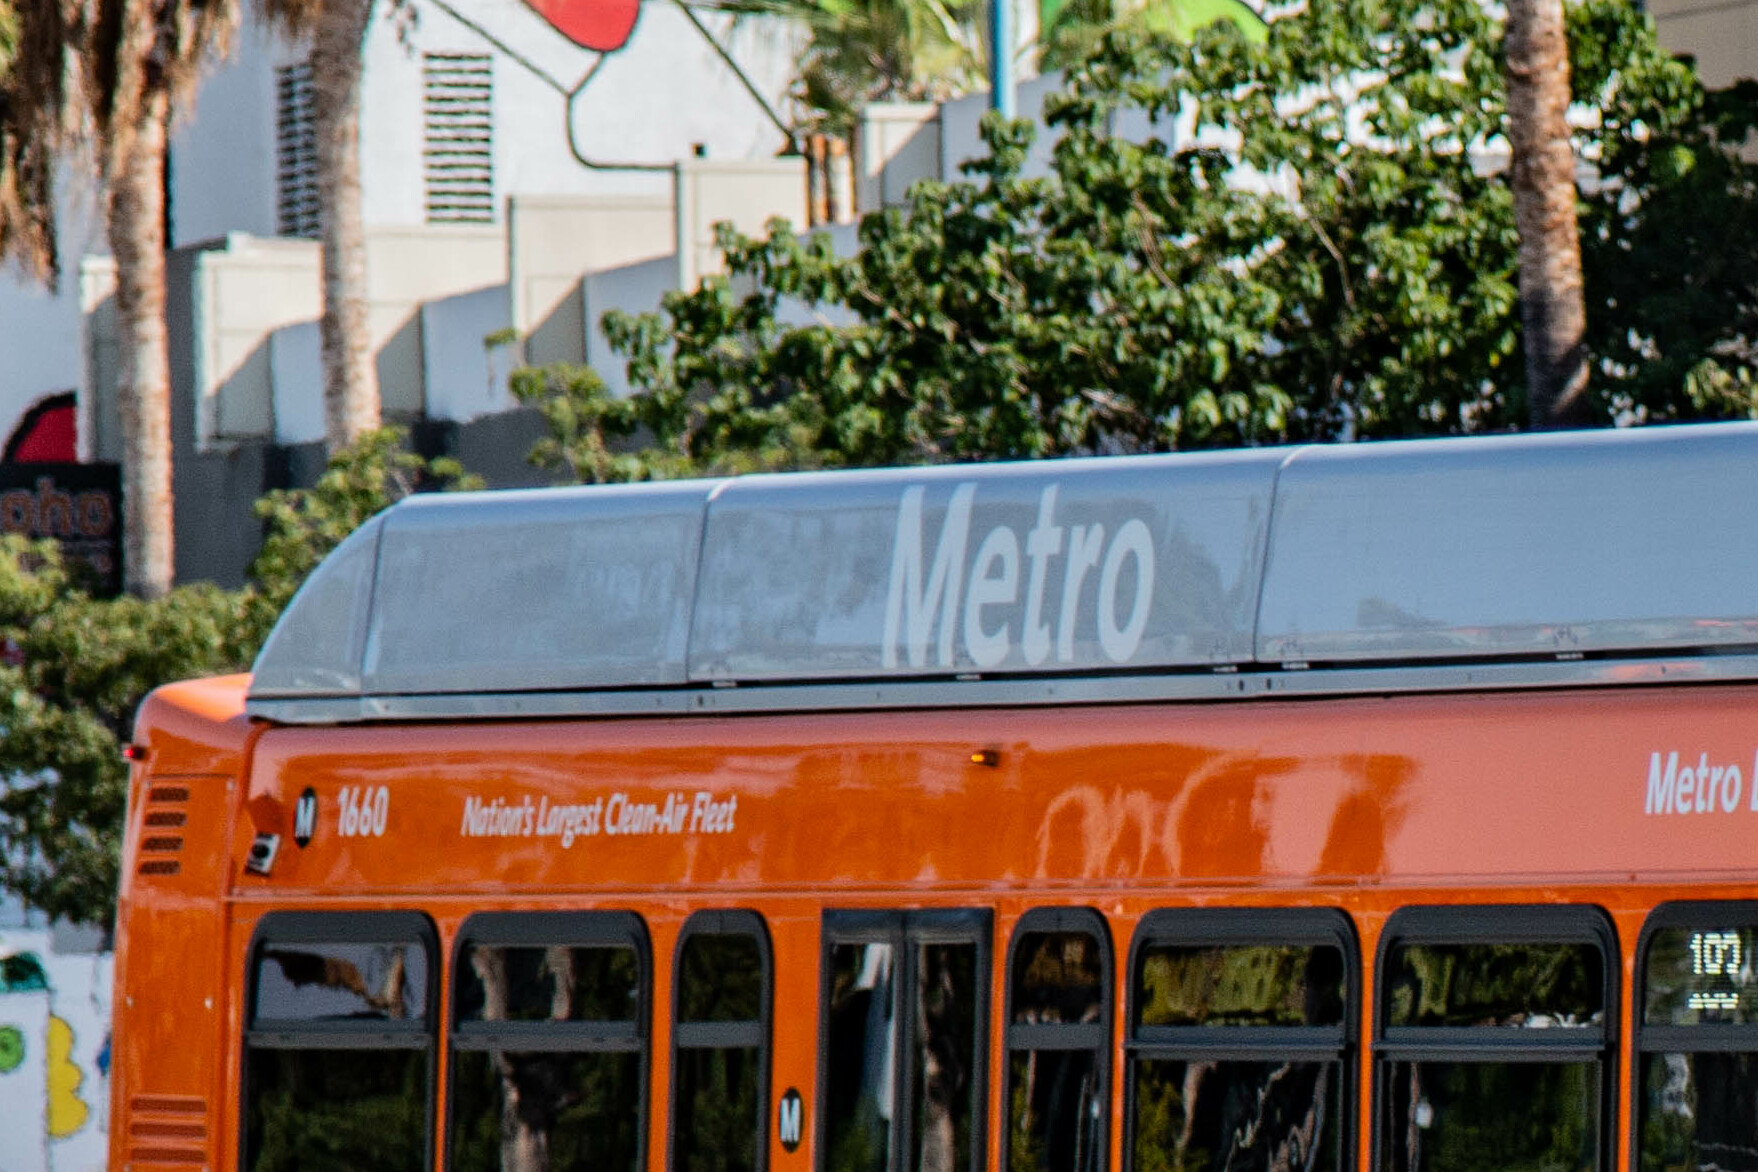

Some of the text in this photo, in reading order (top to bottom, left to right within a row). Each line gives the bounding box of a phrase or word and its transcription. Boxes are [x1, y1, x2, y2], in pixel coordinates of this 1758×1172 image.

[882, 482, 1155, 668] Metro
[338, 786, 389, 837] 1660
[1645, 750, 1742, 815] Metro
[460, 791, 737, 849] Nation's Largest Clean-Air Fleet
